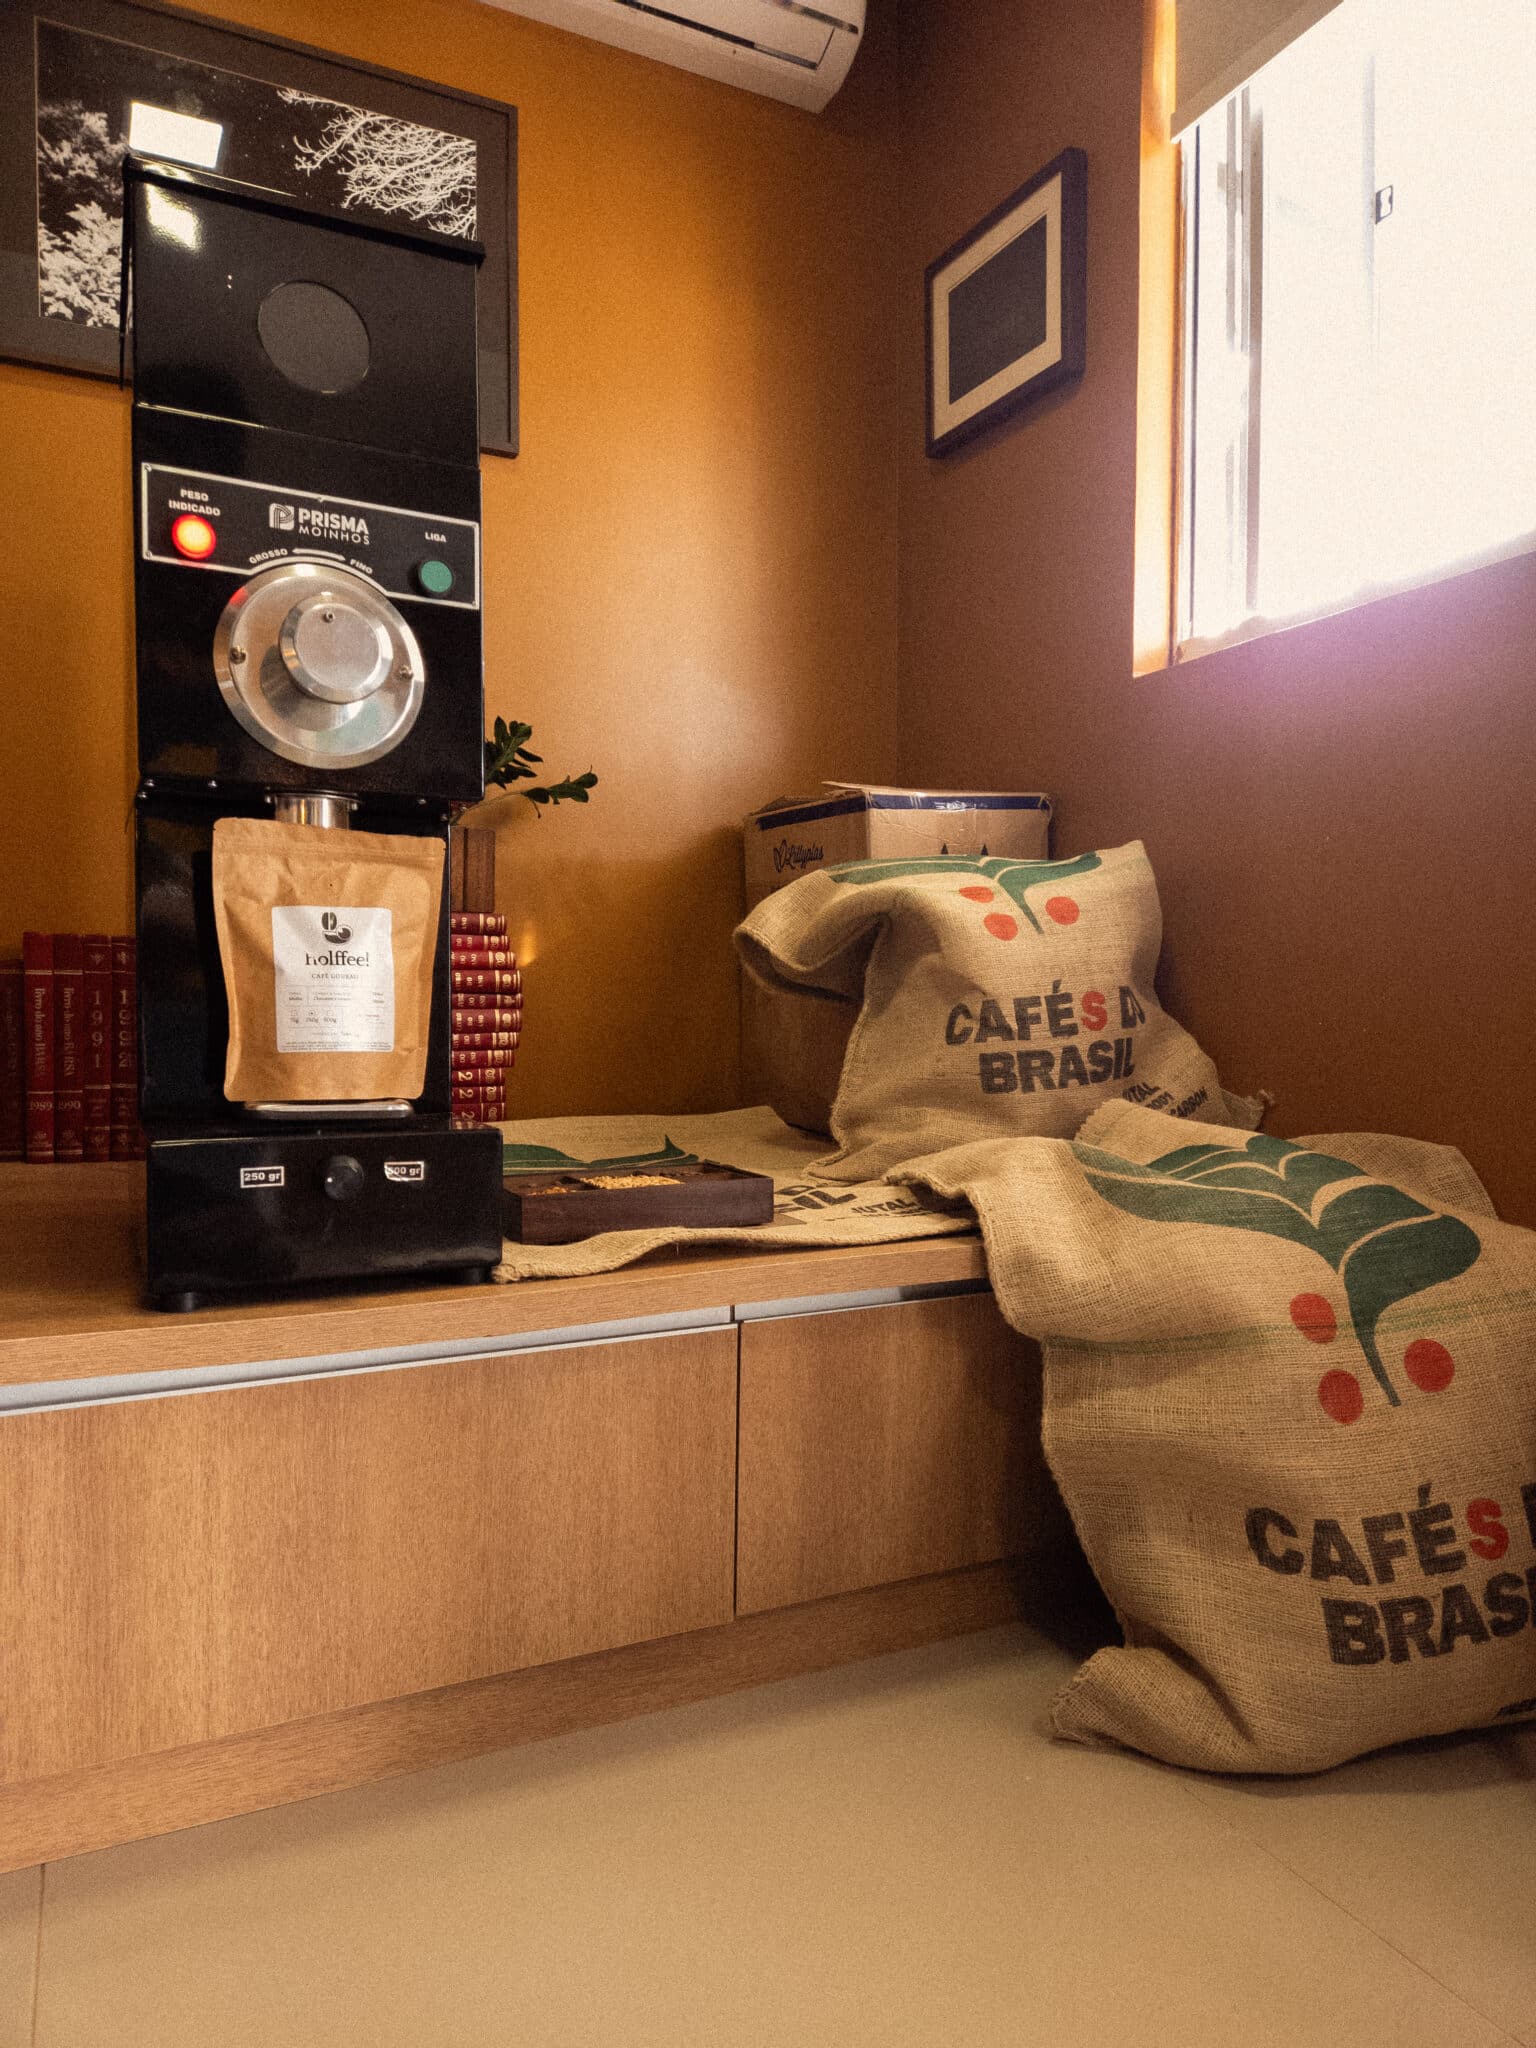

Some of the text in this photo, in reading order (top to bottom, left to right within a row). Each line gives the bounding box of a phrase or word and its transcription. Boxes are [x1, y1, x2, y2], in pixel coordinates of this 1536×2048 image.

[180, 488, 209, 502] PESO
[168, 499, 221, 516] INDICADO
[298, 507, 369, 535] PRISMA
[298, 526, 370, 545] MOINHOS
[424, 531, 447, 543] LIGA
[249, 548, 288, 564] GROSSO
[350, 558, 373, 575] FINO
[945, 979, 1108, 1046] CAFÉS
[978, 1037, 1136, 1095] BRASIL
[244, 1172, 280, 1182] 250 gr
[409, 1168, 421, 1176] gr
[1245, 1482, 1510, 1585] CAFÉS
